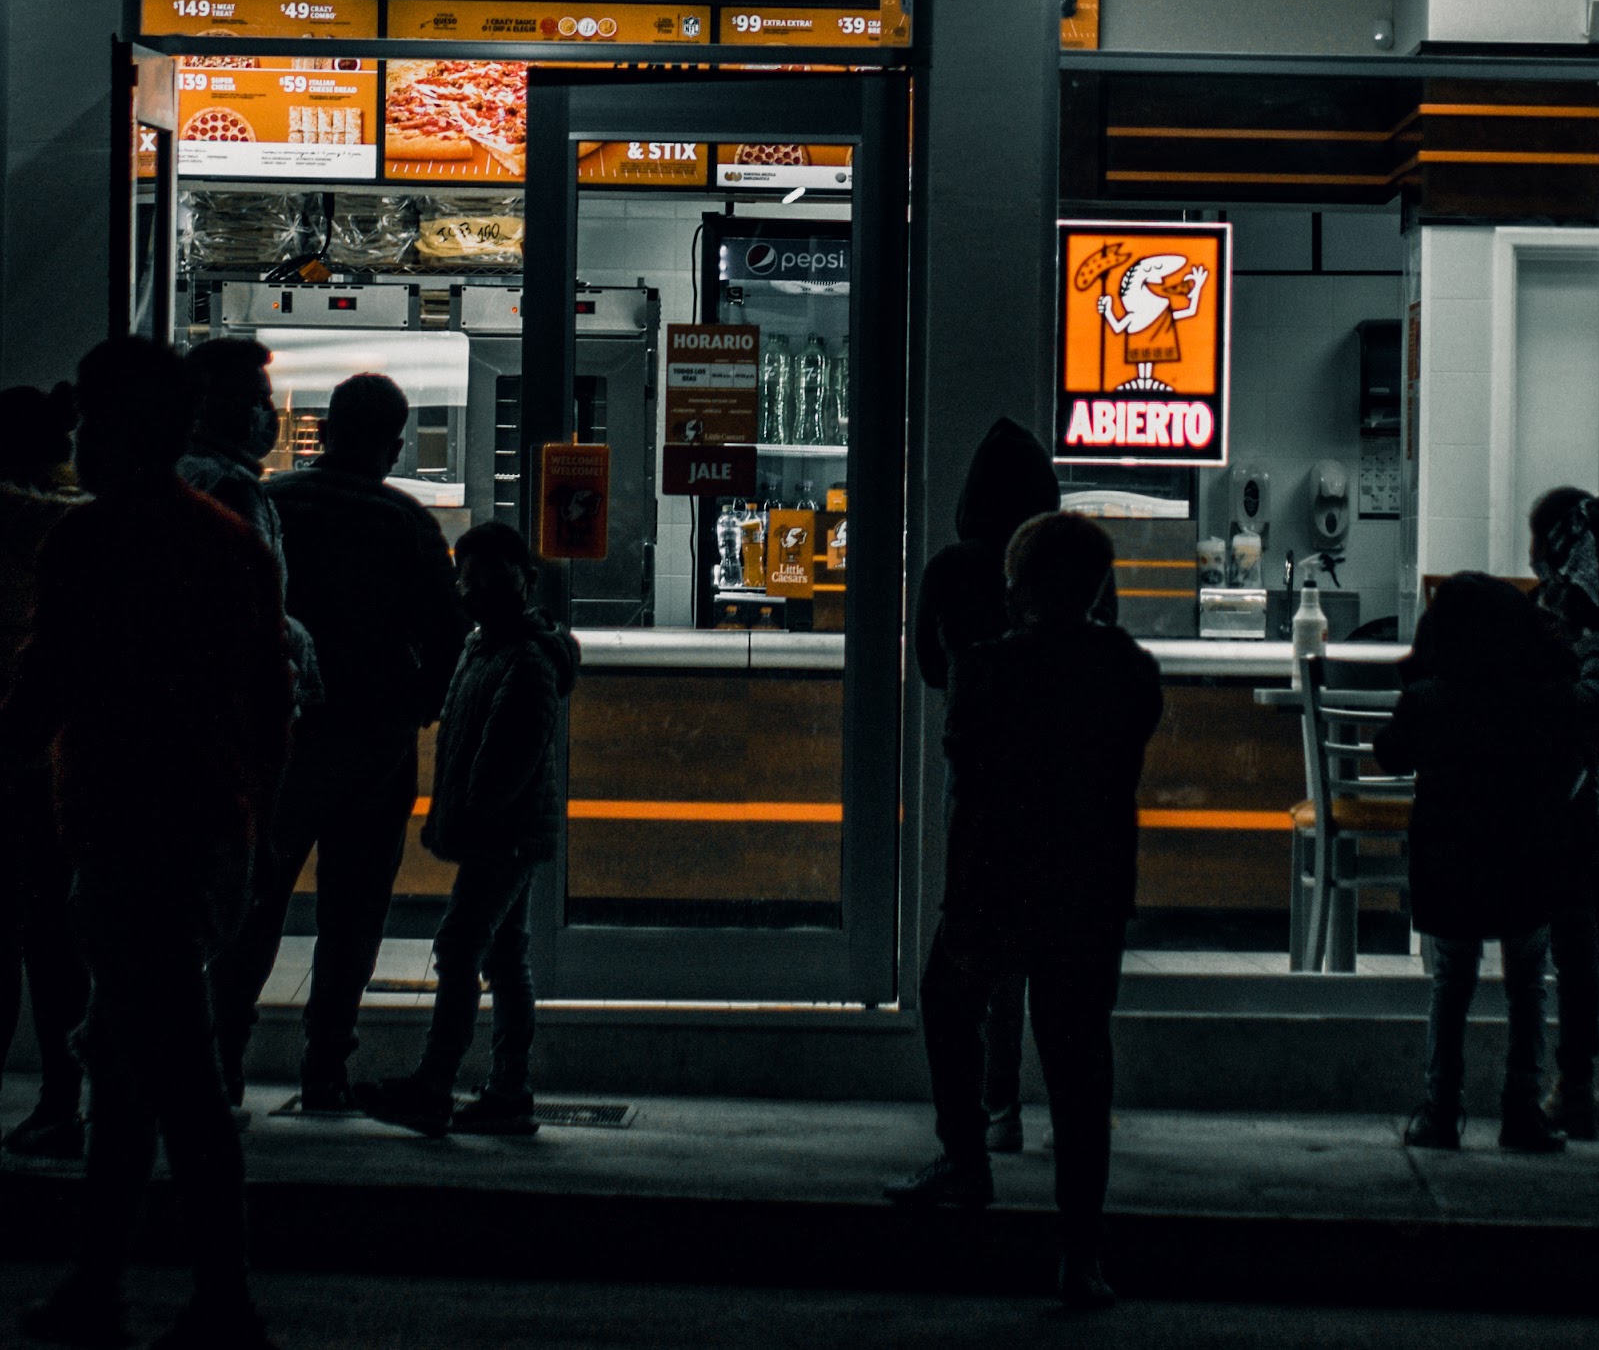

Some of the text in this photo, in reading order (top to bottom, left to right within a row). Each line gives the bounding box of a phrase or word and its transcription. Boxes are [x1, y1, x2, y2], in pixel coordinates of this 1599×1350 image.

[173, 0, 210, 17] $149
[280, 2, 309, 19] $49
[732, 14, 762, 32] $99
[762, 19, 786, 27] EXTRA
[787, 19, 813, 27] EXTRA!
[838, 16, 866, 34] $39
[279, 75, 307, 93] $59
[648, 142, 697, 160] STIX
[781, 250, 845, 273] pepsi
[673, 333, 754, 351] HORARIO
[1066, 400, 1215, 448] ABIERTO
[688, 462, 732, 485] JALE
[771, 571, 808, 584] Caesars
[780, 563, 805, 575] Little
